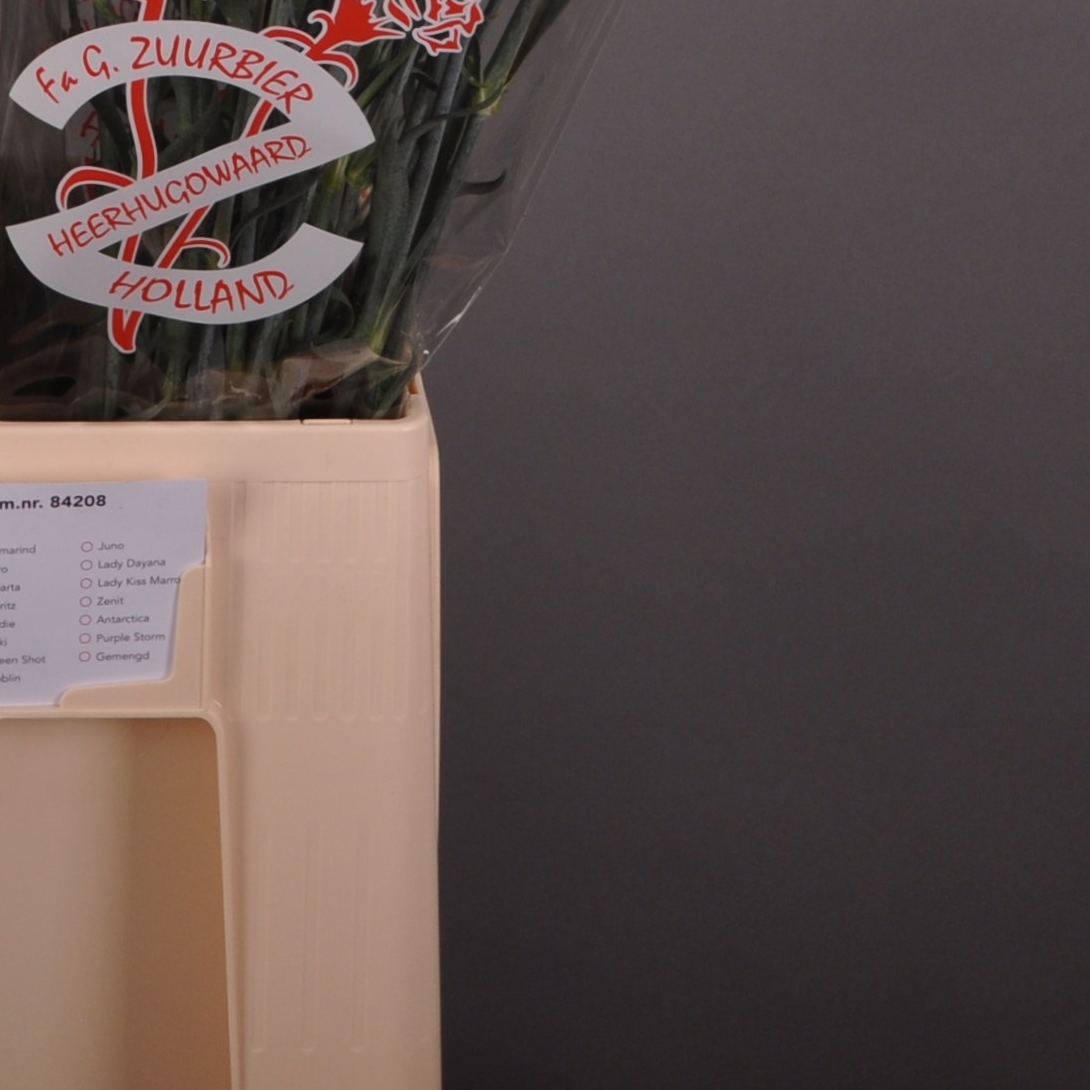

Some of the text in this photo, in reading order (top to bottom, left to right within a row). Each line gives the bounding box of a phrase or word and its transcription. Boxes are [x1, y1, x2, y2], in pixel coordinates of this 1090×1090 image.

[35, 35, 314, 114] Fa G. ZUURBIER
[48, 136, 312, 257] HEERHUGOWAARD
[110, 271, 295, 314] HOLLAND
[50, 495, 106, 508] 84208
[98, 542, 124, 551] Juno
[98, 559, 166, 570] Lady Dayana
[98, 579, 122, 588] Lady
[126, 578, 146, 586] Kiss
[97, 597, 124, 606] Zenit
[96, 615, 149, 624] Antarctica
[97, 633, 165, 643] Purple Storm
[22, 656, 46, 664] Shot
[96, 651, 149, 662] Gemengd
